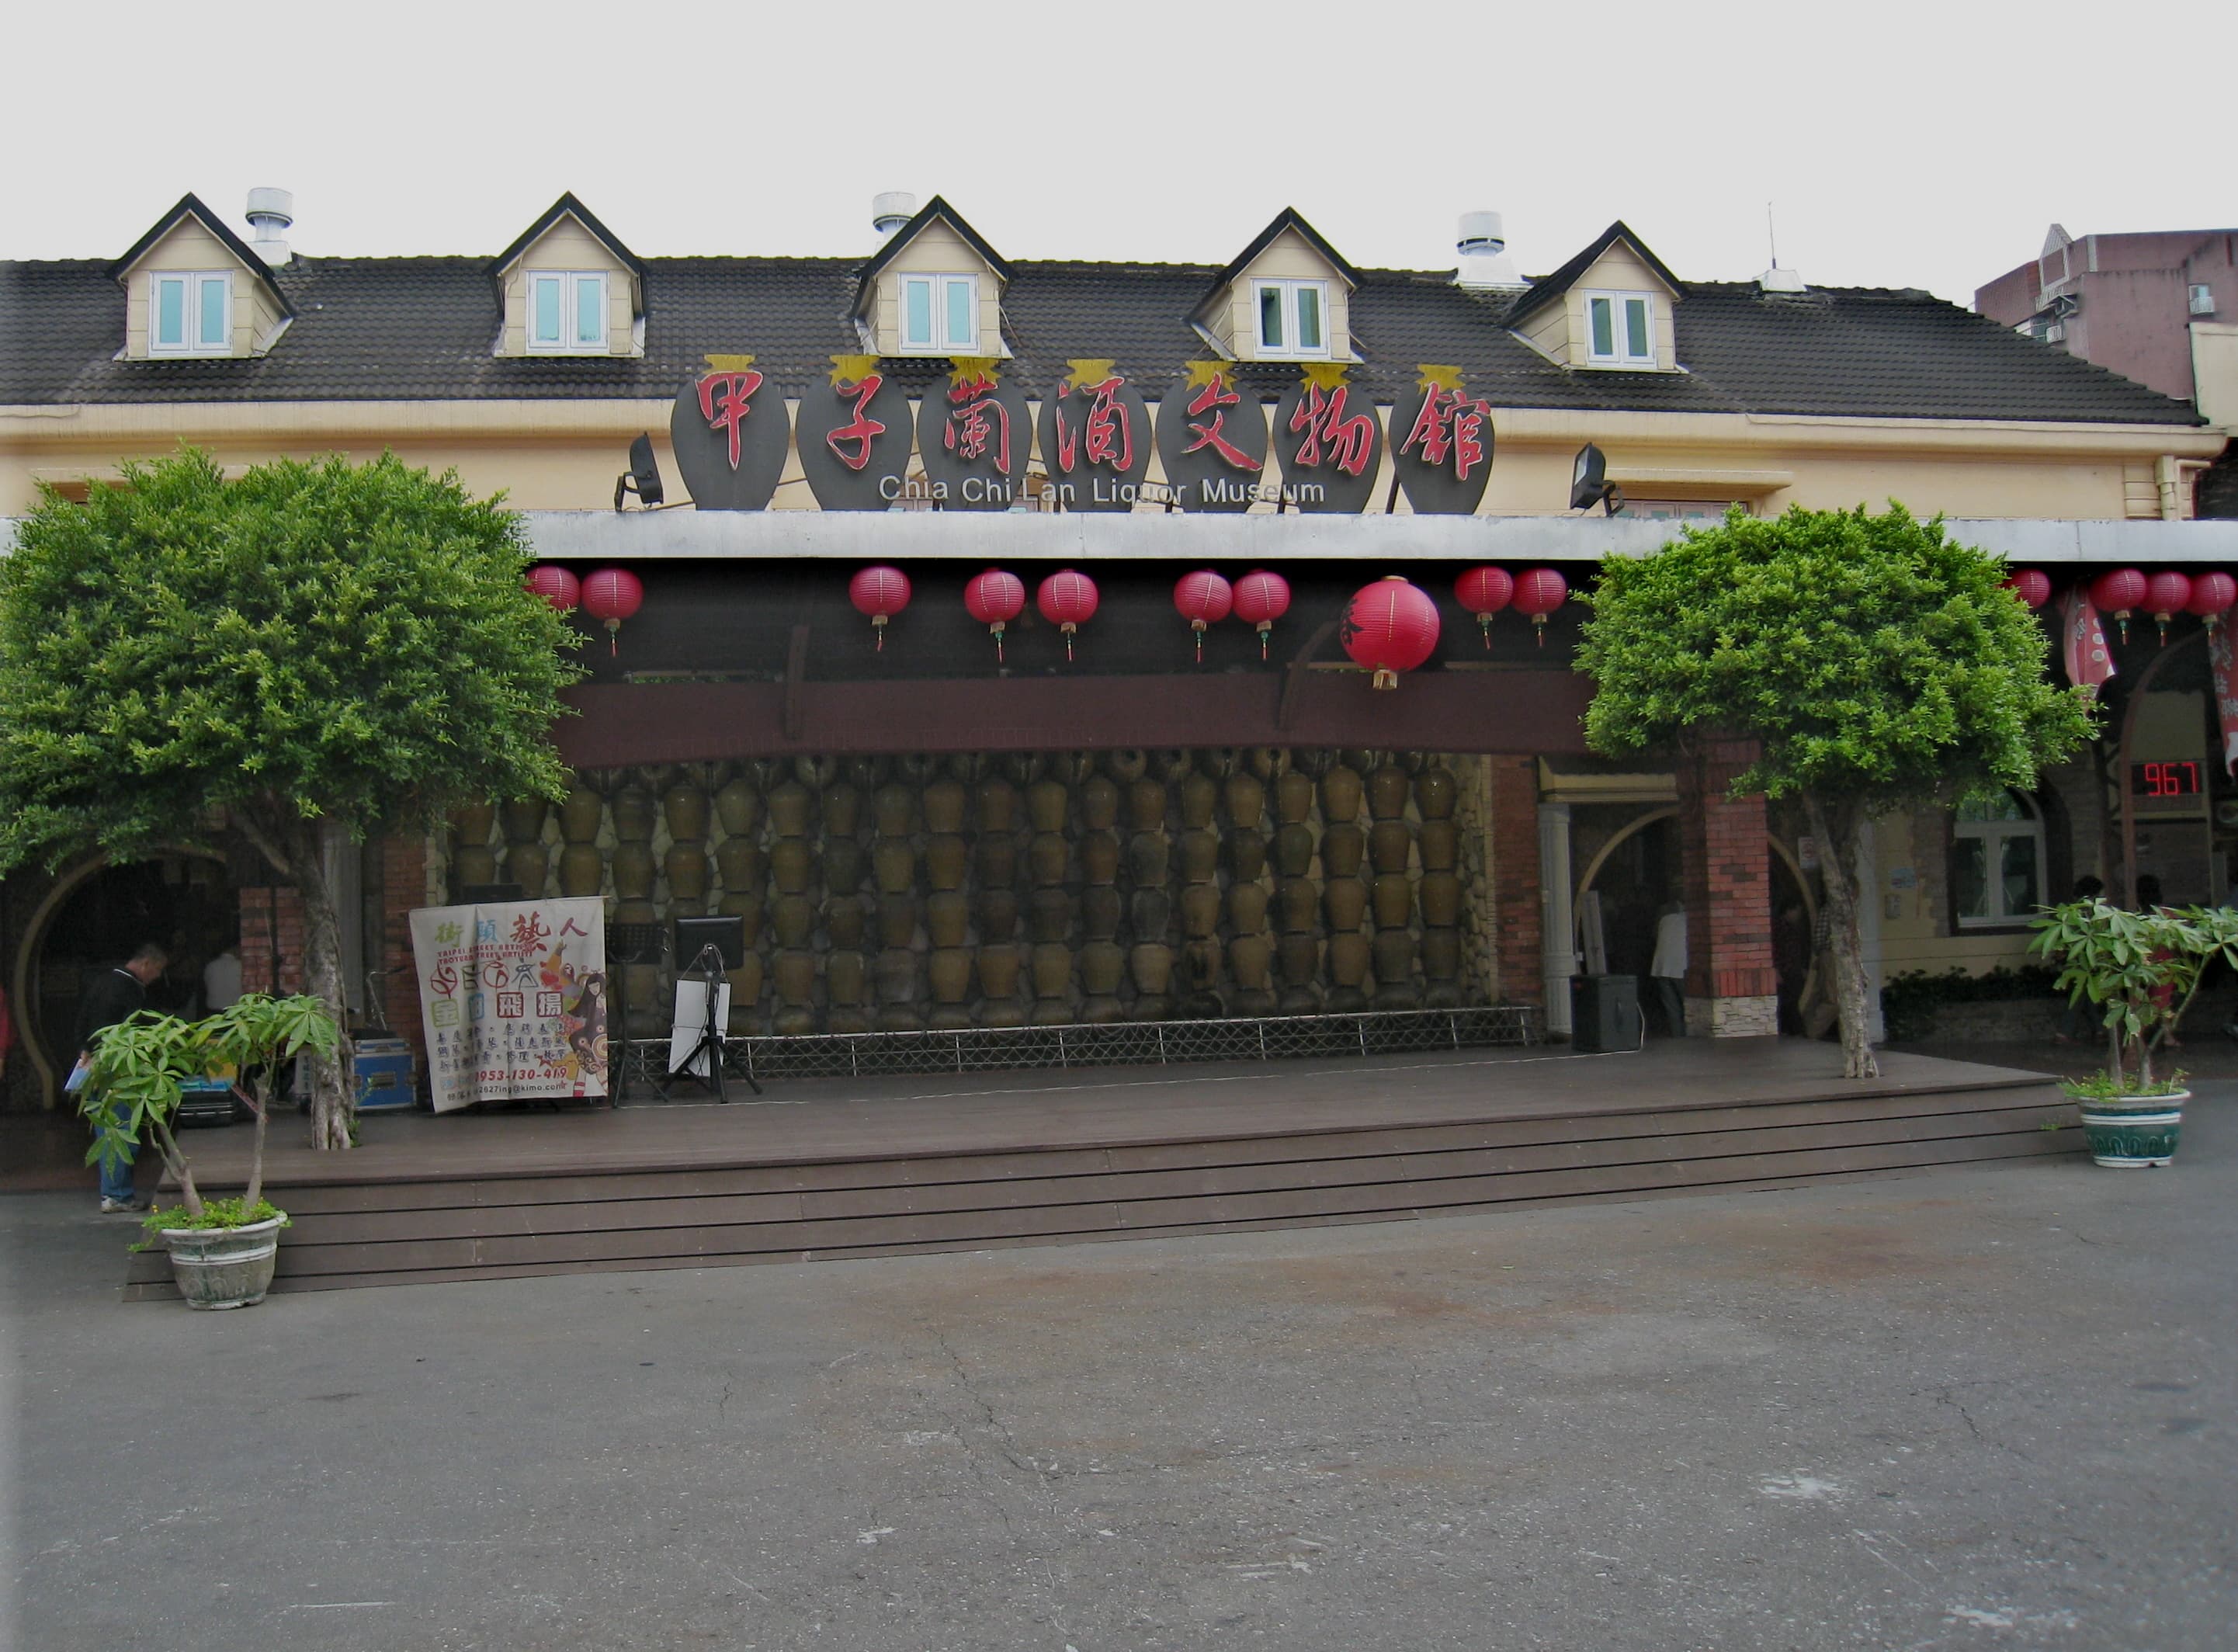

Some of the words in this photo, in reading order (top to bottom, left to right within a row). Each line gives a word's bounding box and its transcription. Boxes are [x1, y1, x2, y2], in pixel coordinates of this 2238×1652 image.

[696, 370, 1490, 481] 甲子蘭酒文物館
[879, 476, 949, 502] Chia
[961, 477, 1011, 503] Chi
[1022, 477, 1075, 502] Lan
[1092, 477, 1188, 509] Liquor
[1202, 477, 1325, 503] Museum
[2145, 762, 2199, 796] 967
[434, 911, 588, 952] 街頭藝人
